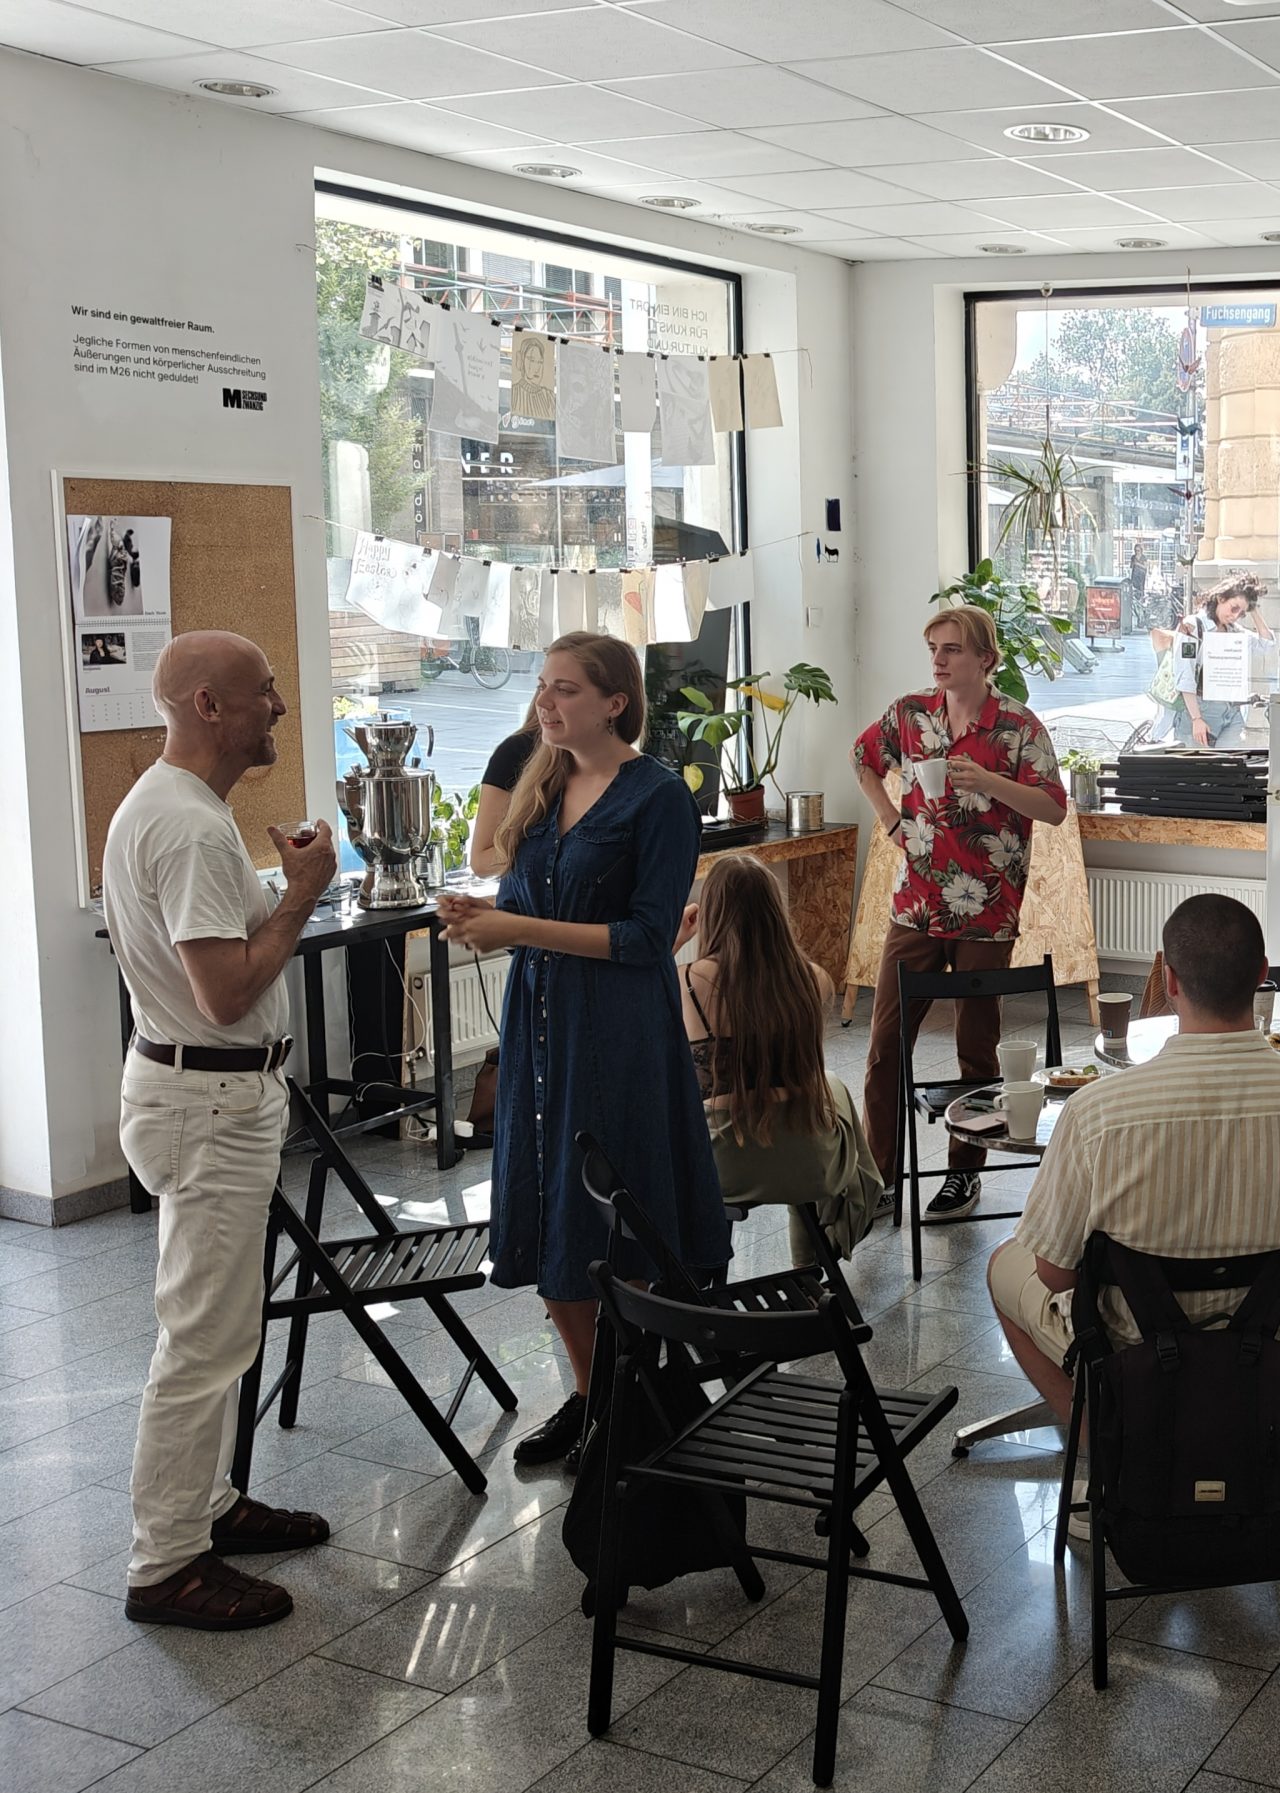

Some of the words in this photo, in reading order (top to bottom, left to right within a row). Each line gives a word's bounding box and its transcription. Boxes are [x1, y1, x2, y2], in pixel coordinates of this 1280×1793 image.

[71, 305, 88, 317] Wir
[90, 308, 111, 320] sind
[113, 311, 128, 322] ein
[130, 313, 185, 330] gewaltfreier
[187, 321, 215, 334] Raum.
[1206, 305, 1271, 323] Fuchsengang
[73, 334, 113, 348] Jegliche
[116, 339, 151, 352] Formen
[153, 345, 170, 354] von
[171, 346, 261, 366] menschenfeindlichen
[73, 347, 131, 364] Äußerungen
[133, 354, 151, 365] und
[153, 356, 206, 372] körperlicher
[207, 363, 266, 380] Ausschreitung
[74, 363, 94, 374] sind
[96, 365, 108, 375] im
[110, 366, 131, 377] M26
[133, 369, 156, 380] nicht
[157, 371, 199, 384] geduldet!
[222, 388, 242, 409] M
[85, 686, 110, 694] August
